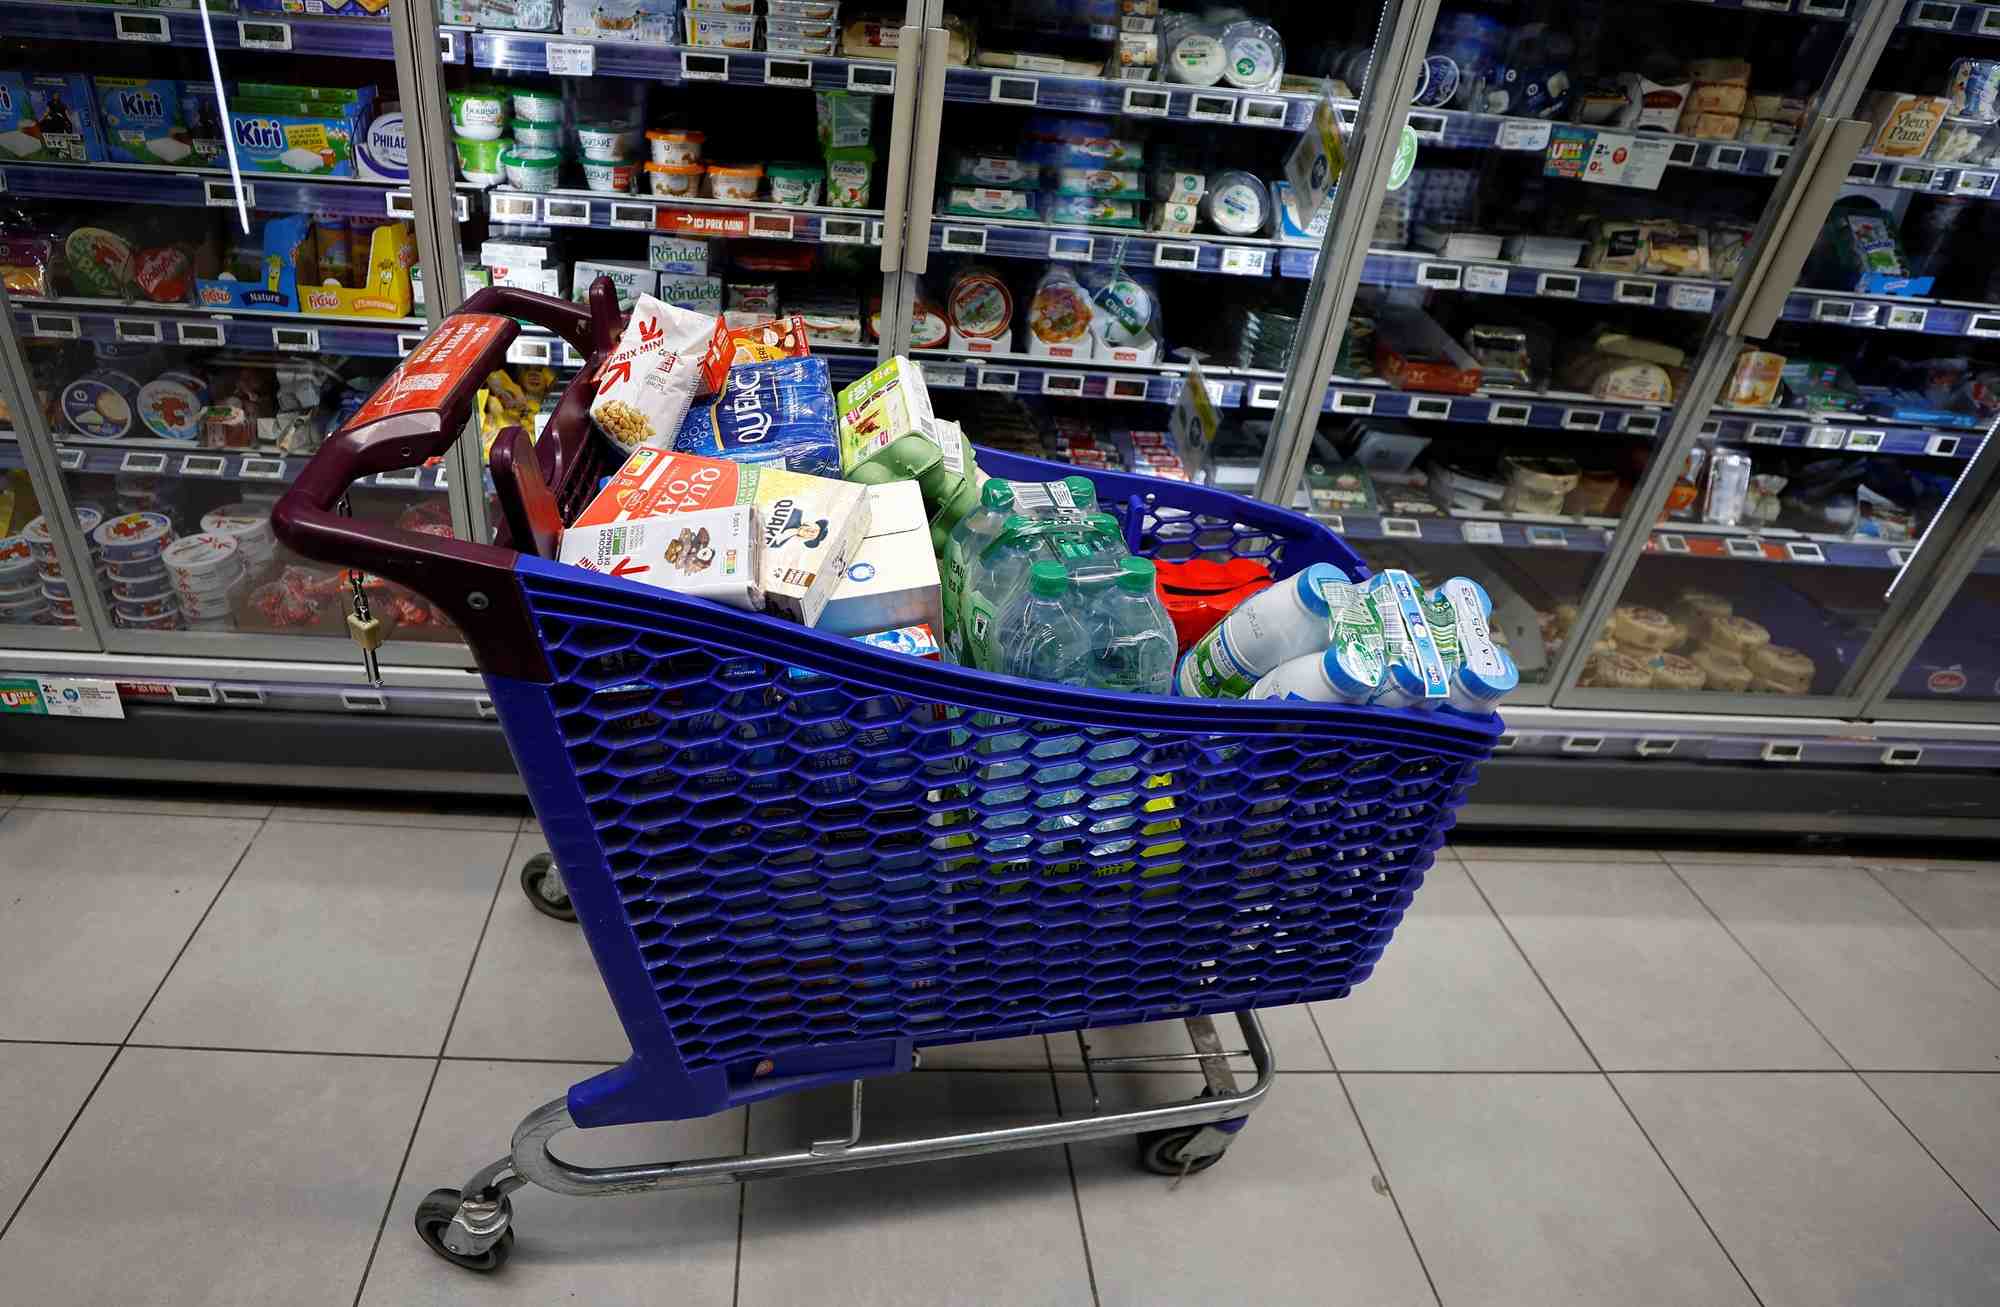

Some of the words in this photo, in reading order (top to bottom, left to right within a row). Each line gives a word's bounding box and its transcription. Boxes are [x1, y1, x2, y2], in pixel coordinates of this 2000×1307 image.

[120, 91, 163, 117] Kiri
[234, 119, 283, 148] Kiri
[705, 219, 723, 230] PRIX
[249, 291, 280, 304] Nature
[640, 338, 664, 354] MINI
[597, 528, 606, 567] CHOCOLAT
